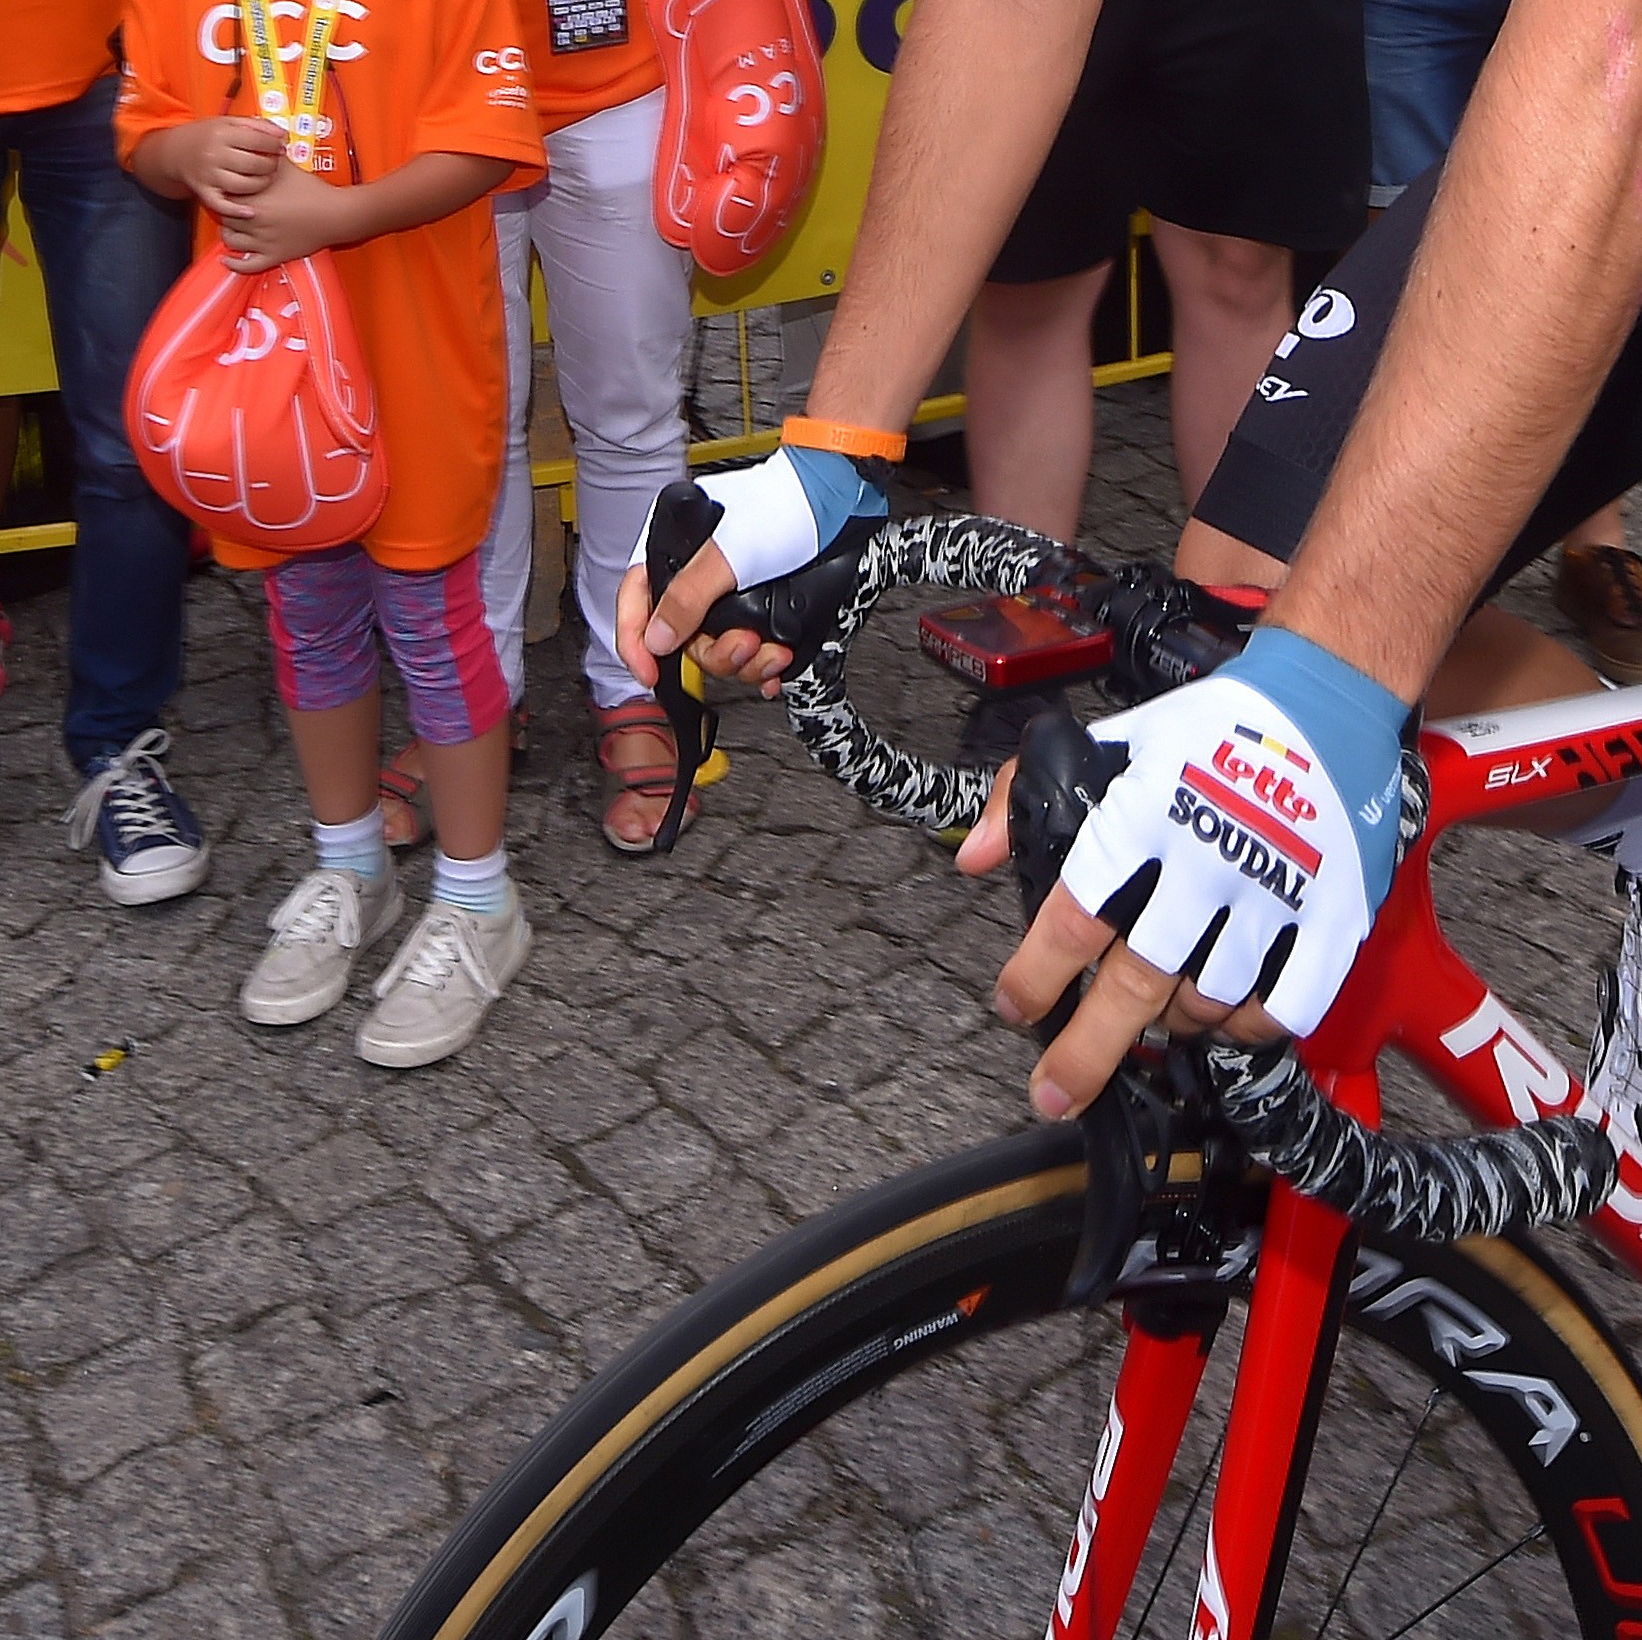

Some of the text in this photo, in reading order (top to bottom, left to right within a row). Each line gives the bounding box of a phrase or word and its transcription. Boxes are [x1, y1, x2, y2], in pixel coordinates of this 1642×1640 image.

[1485, 754, 1553, 791] SLX
[1168, 786, 1316, 913] SOUDAL
[893, 1311, 959, 1350] WARNING
